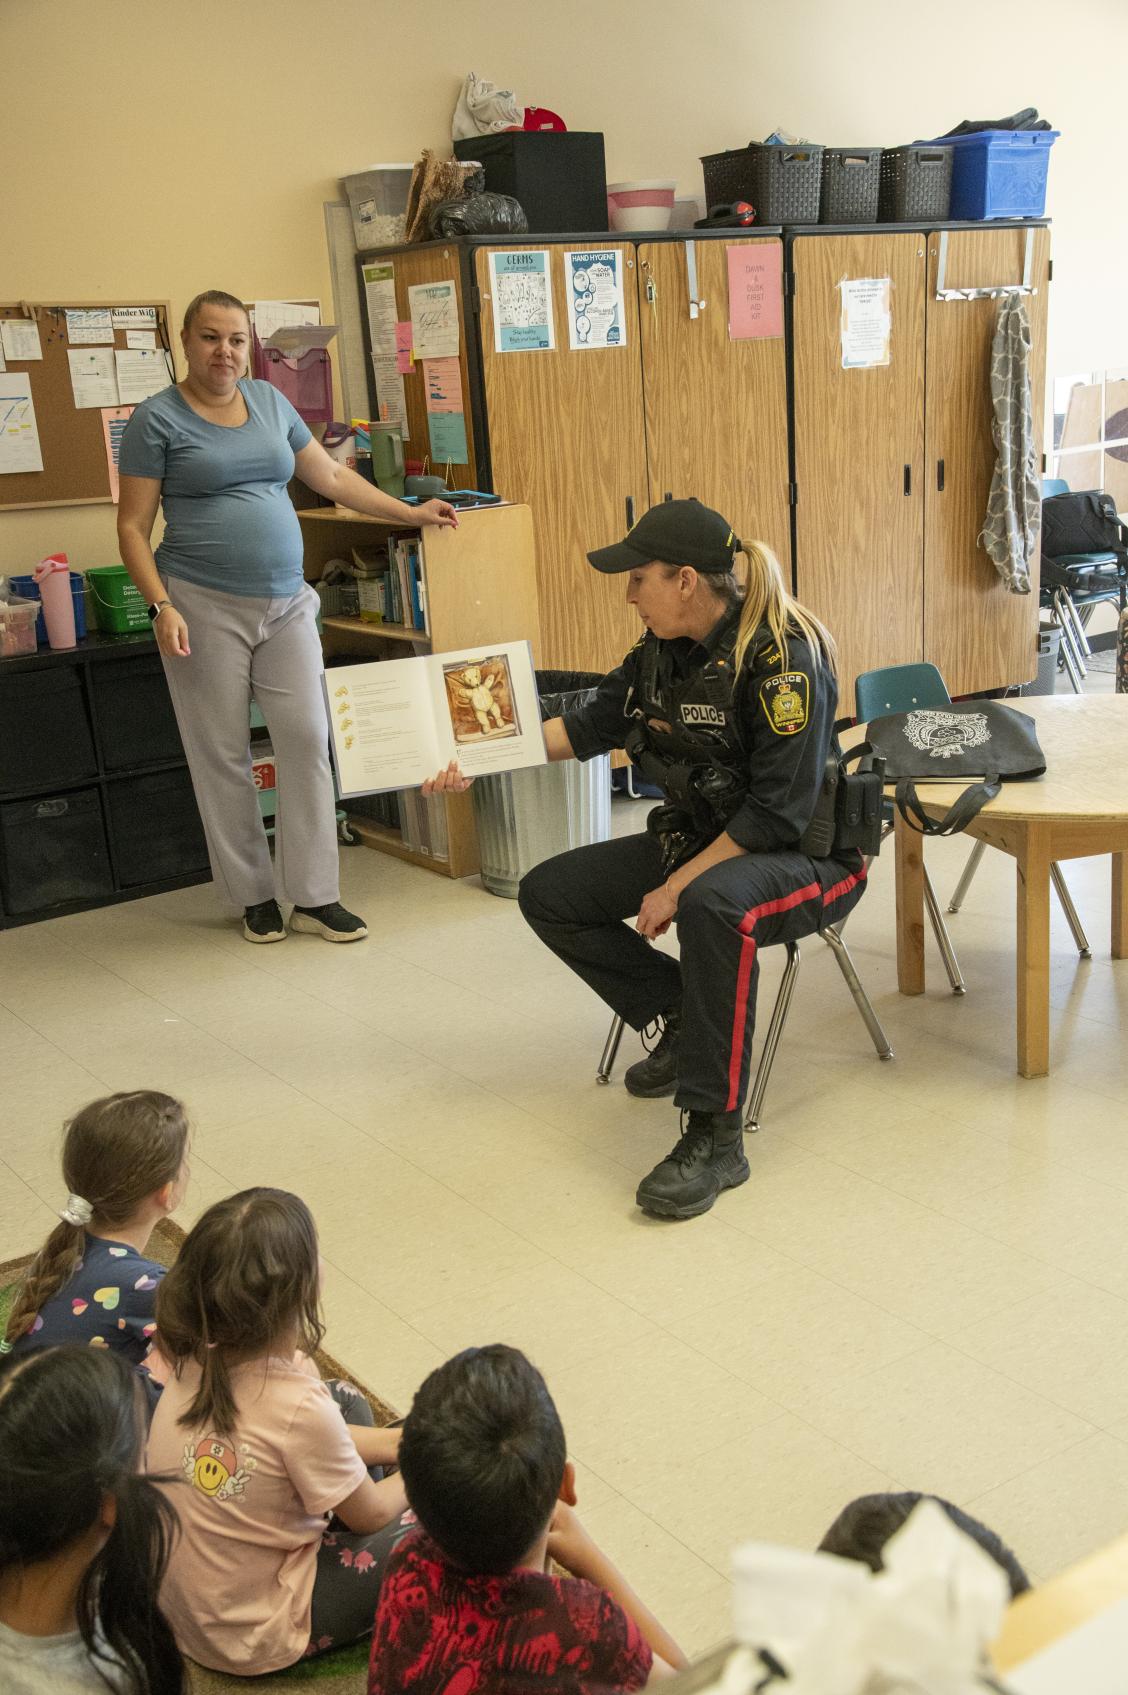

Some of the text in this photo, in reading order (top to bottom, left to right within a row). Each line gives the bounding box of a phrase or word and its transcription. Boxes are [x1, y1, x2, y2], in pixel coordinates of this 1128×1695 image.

[507, 254, 533, 264] GERMS
[572, 253, 614, 262] HAND HYGIENE
[745, 265, 765, 273] DAWN
[746, 293, 764, 301] FIRST
[112, 309, 137, 317] Kinder
[752, 312, 761, 320] KIT
[765, 675, 802, 690] POLICE
[683, 706, 724, 722] POLICE
